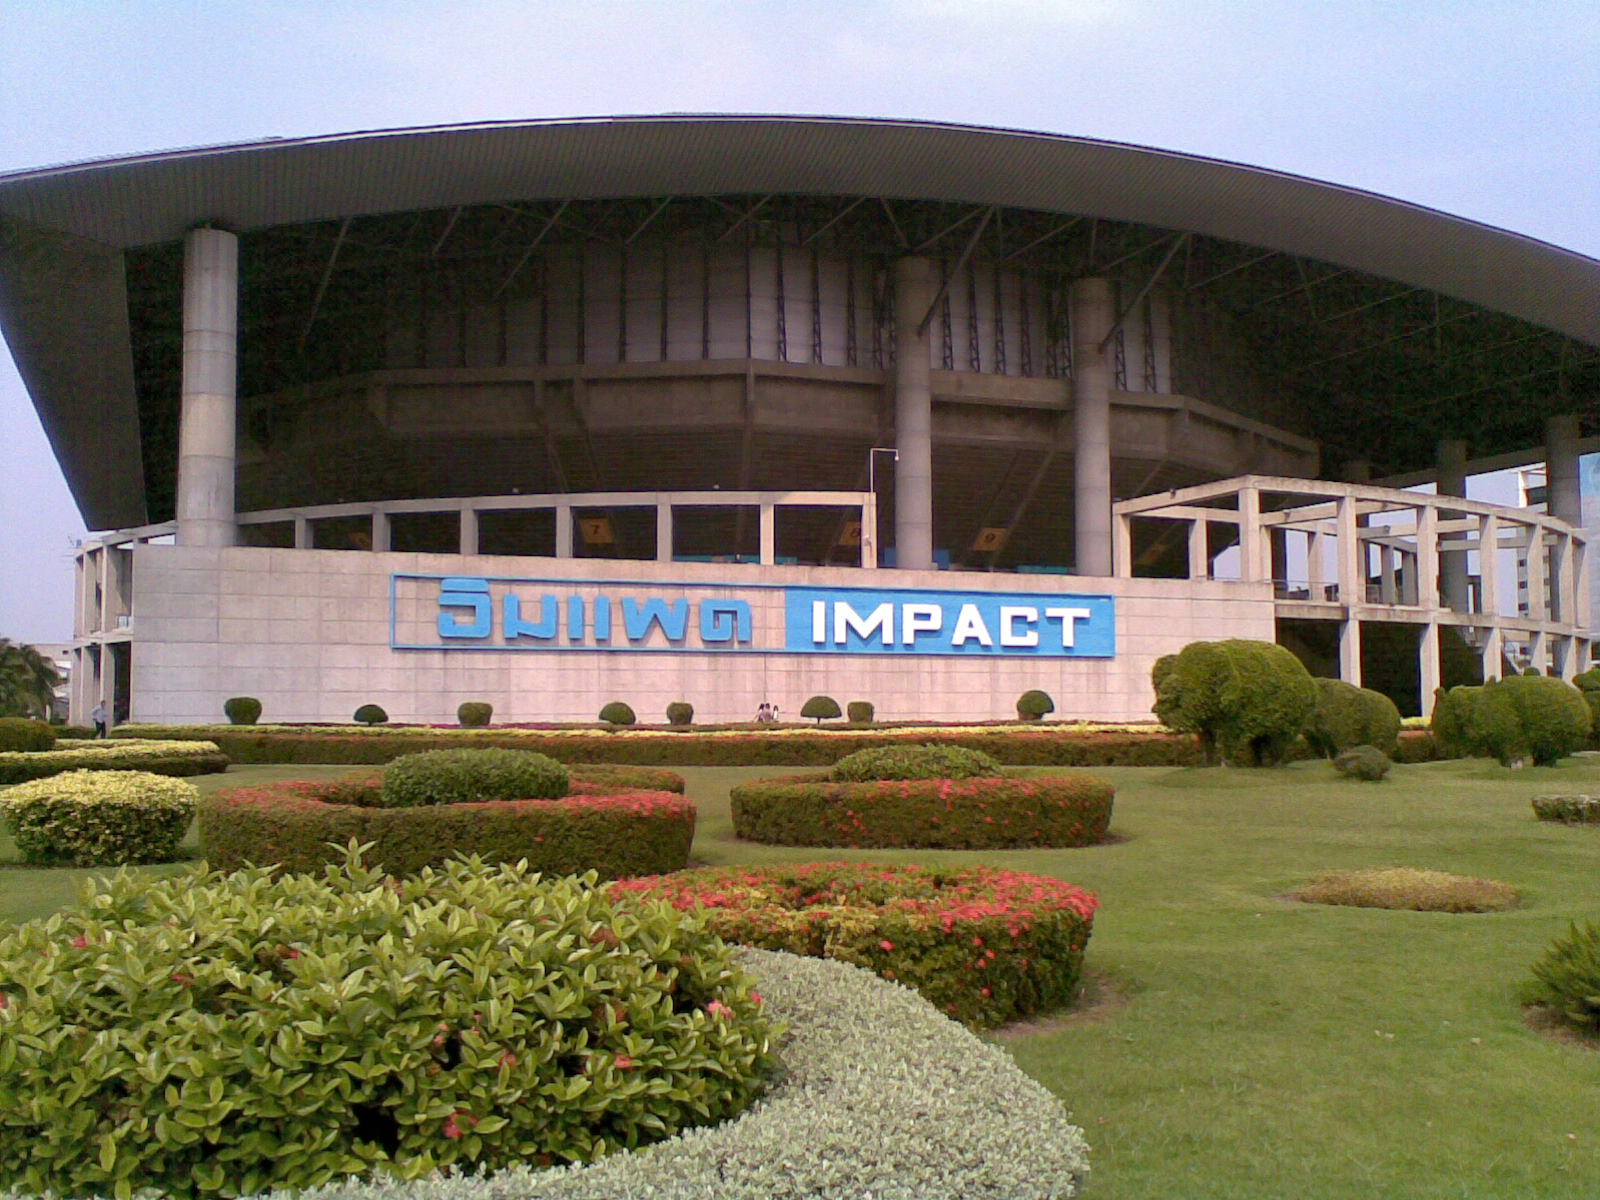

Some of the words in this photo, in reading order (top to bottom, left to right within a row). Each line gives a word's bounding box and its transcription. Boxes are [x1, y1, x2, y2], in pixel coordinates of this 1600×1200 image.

[590, 523, 601, 535] 7
[438, 578, 752, 644] อิมแพค
[812, 600, 1091, 648] IMPACT
